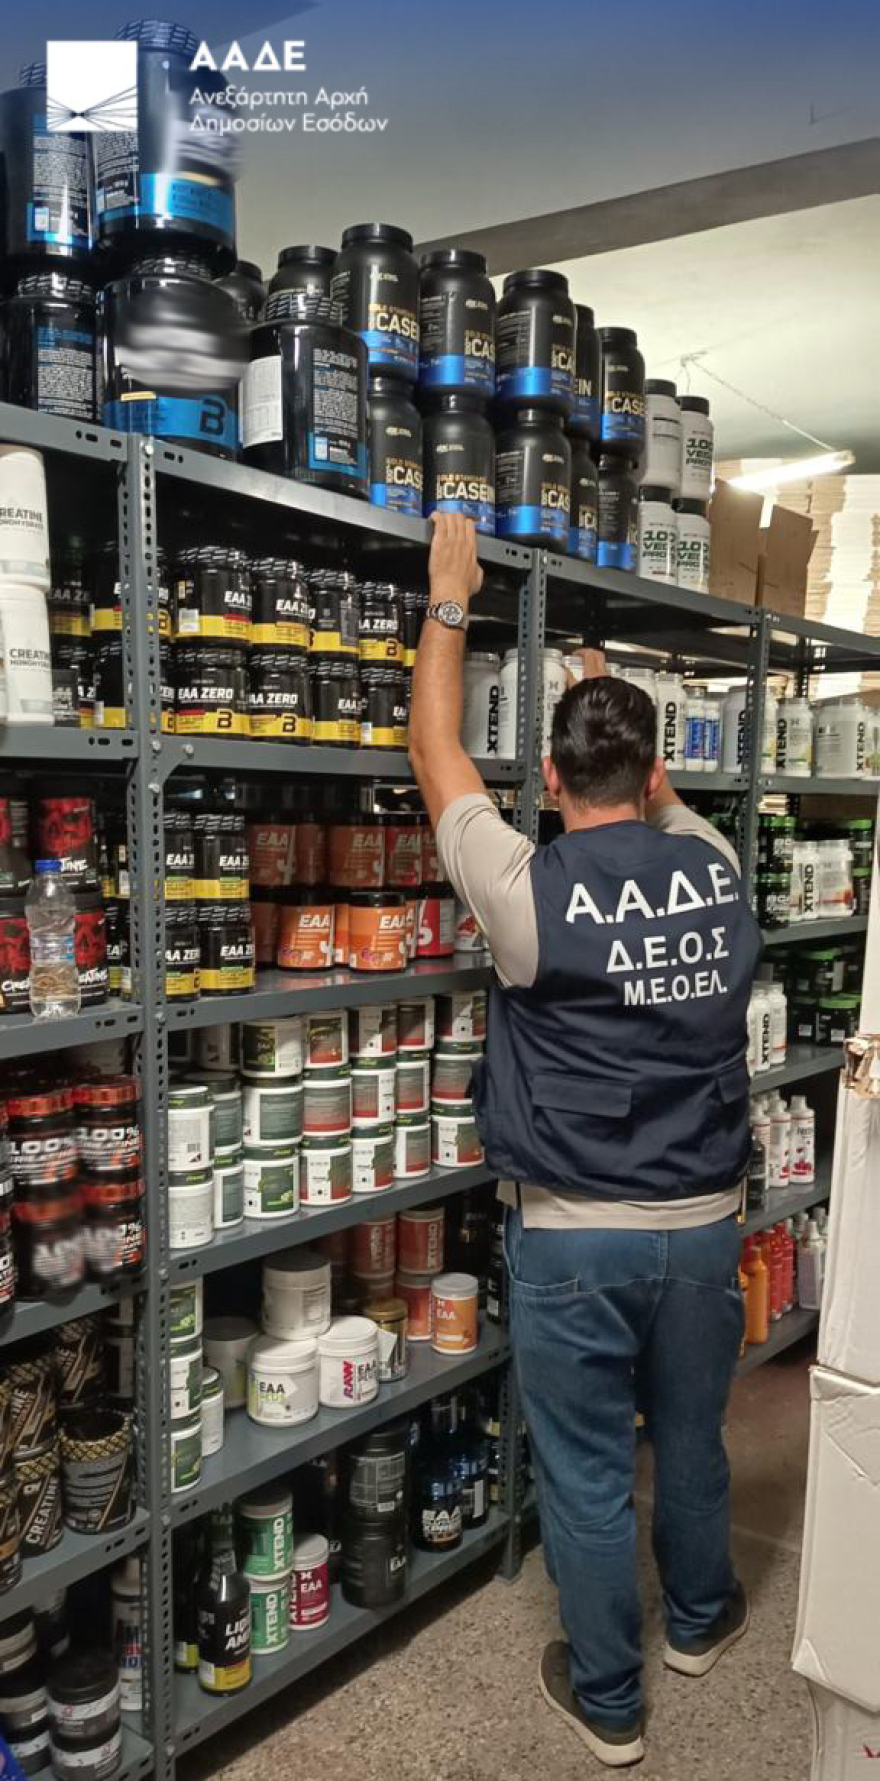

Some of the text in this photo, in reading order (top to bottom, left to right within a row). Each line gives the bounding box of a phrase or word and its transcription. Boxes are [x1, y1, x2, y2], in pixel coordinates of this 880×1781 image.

[201, 687, 234, 699] ZERO
[266, 692, 298, 704] ZERO
[487, 685, 499, 754] XTEND
[664, 701, 677, 762] XTEND
[776, 718, 788, 769] XTEND
[857, 721, 866, 771] XTEND
[804, 863, 814, 912] XTEND
[299, 914, 330, 928] EAA
[761, 1013, 770, 1064] XTEND
[260, 1382, 285, 1394] EAA
[300, 1579, 322, 1593] EAA
